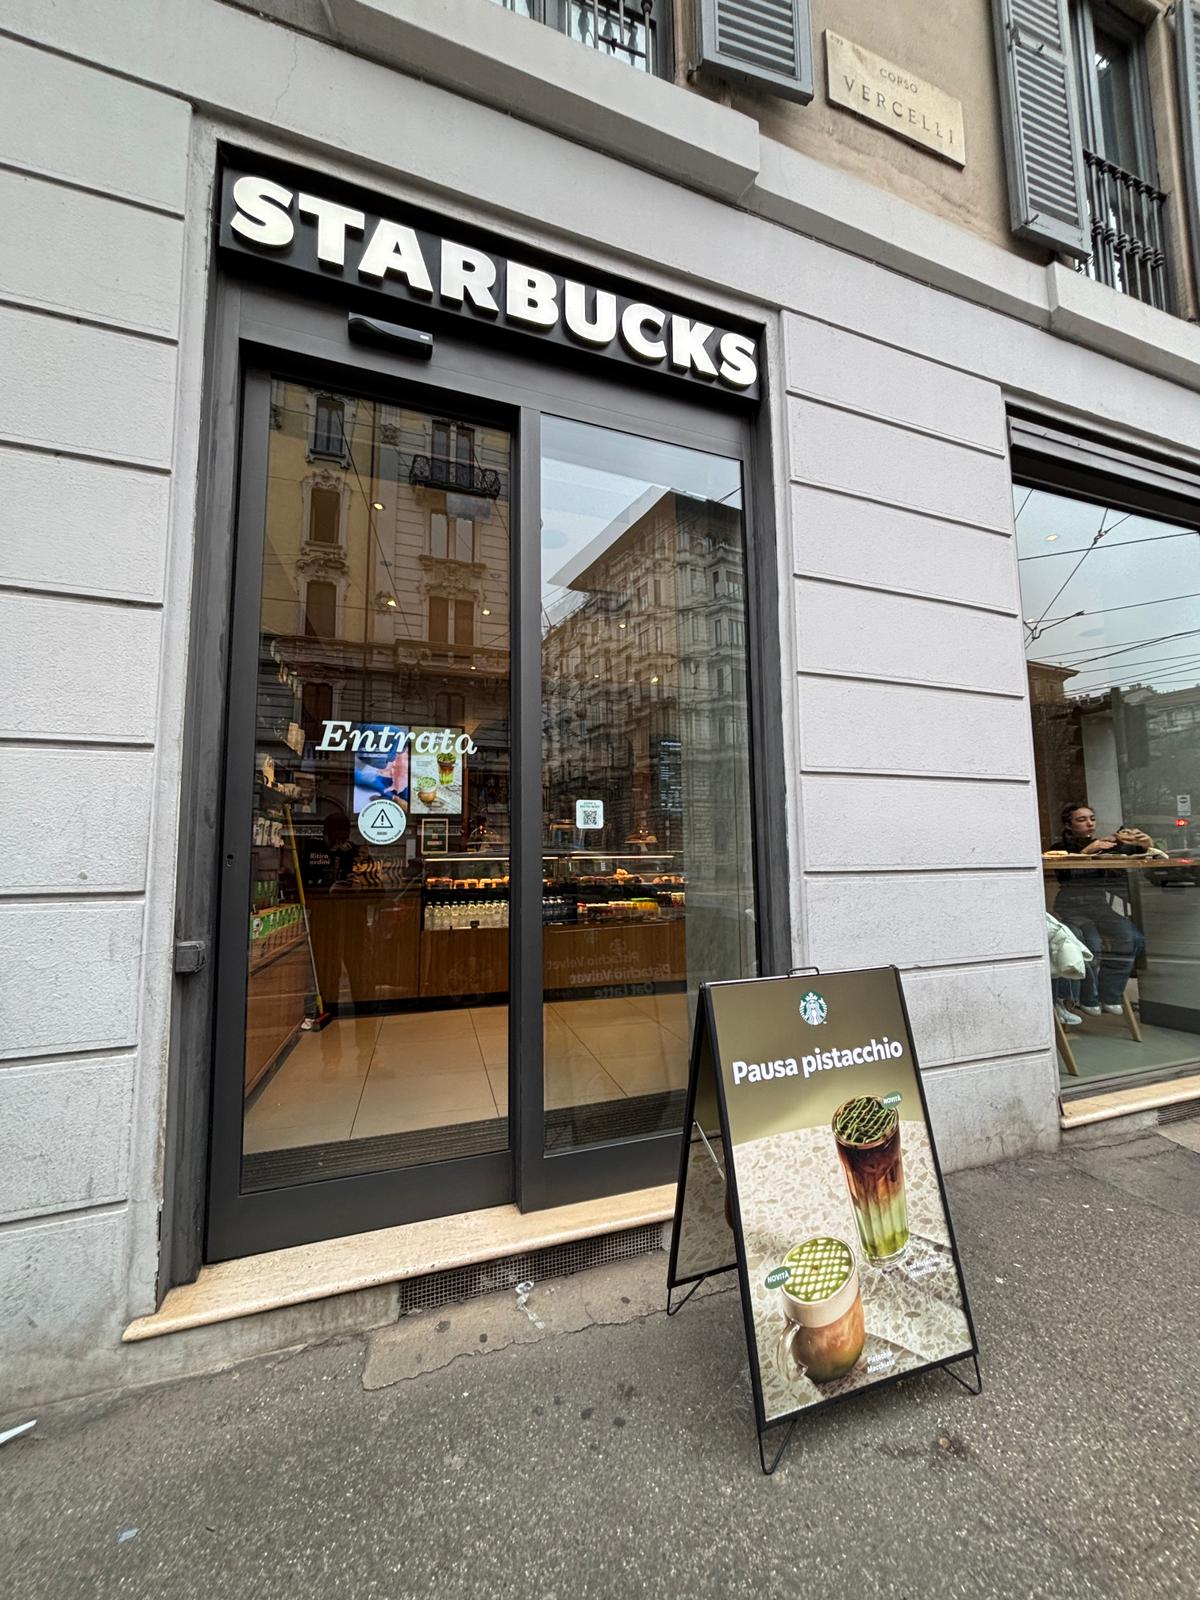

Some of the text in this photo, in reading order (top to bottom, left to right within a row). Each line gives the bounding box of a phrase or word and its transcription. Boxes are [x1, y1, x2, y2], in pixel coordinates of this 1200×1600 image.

[879, 67, 918, 94] CORSO
[843, 75, 953, 144] VERCELLI
[230, 176, 758, 387] STARBUCKS
[315, 720, 478, 755] Entrata
[732, 1037, 903, 1085] Pausa pistacchio
[767, 1270, 789, 1284] NOVITÀ
